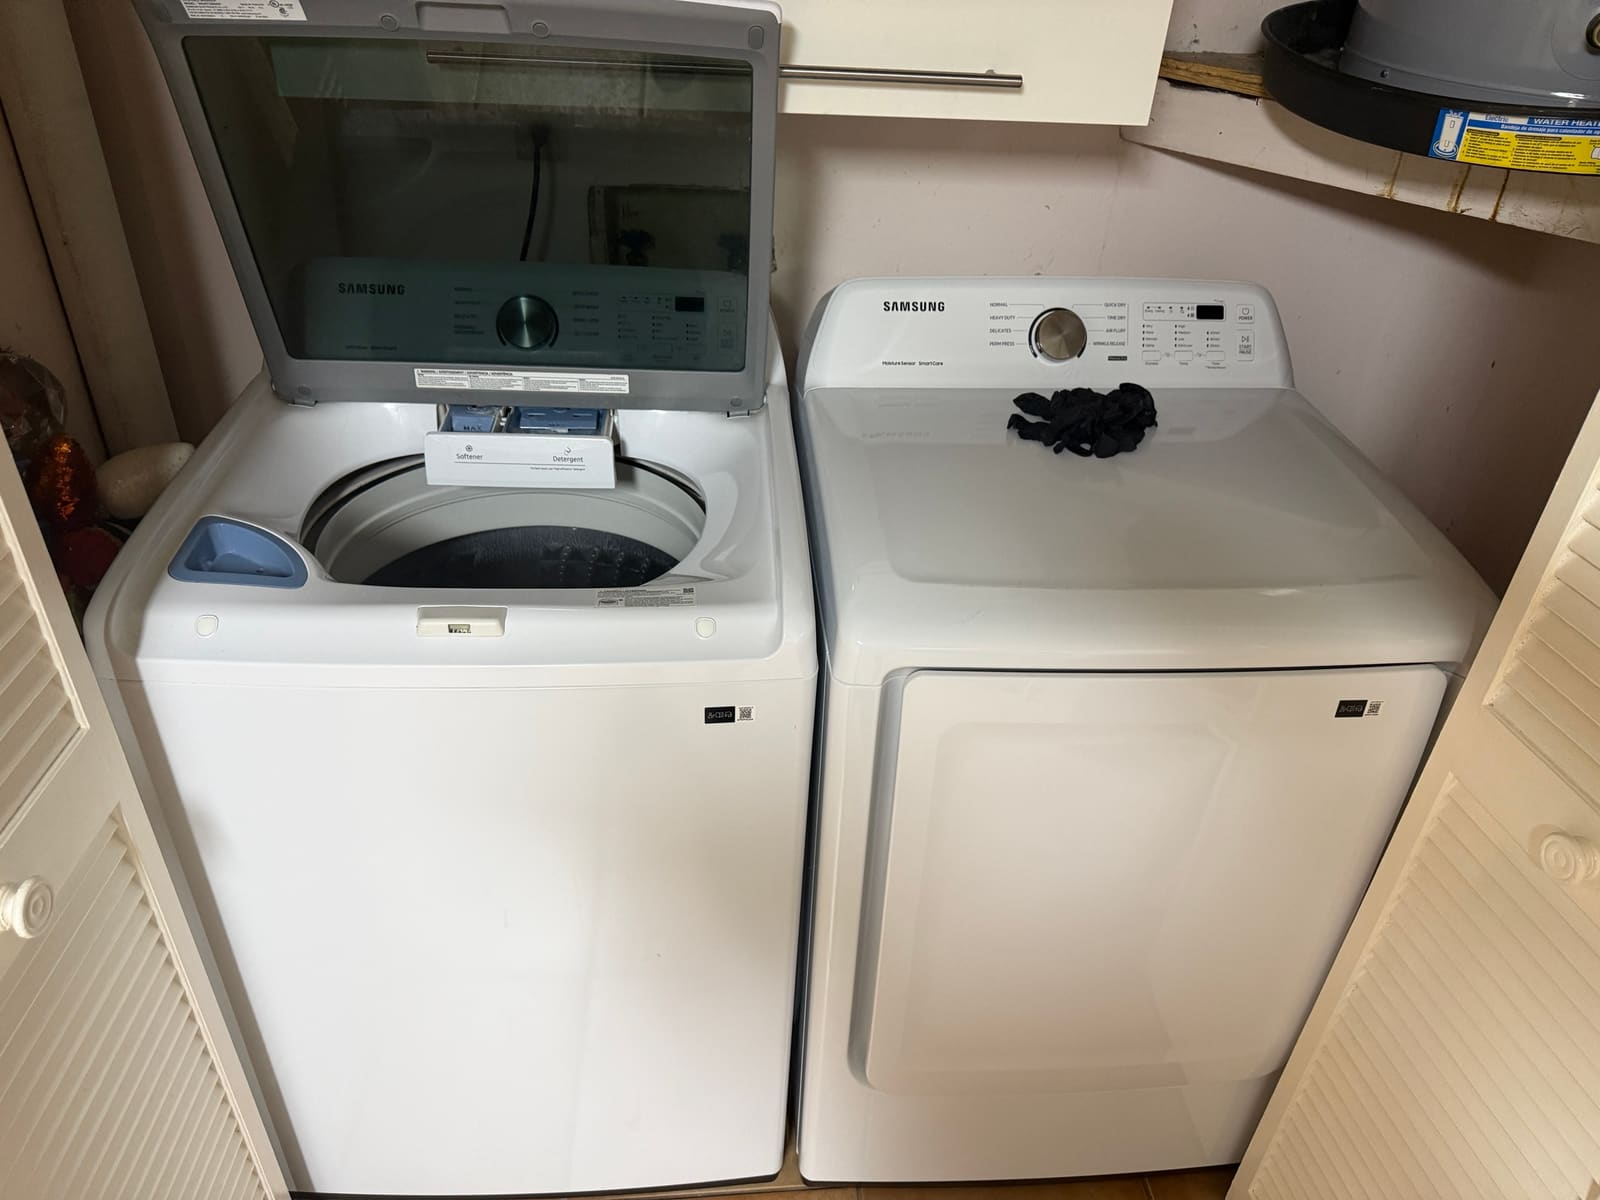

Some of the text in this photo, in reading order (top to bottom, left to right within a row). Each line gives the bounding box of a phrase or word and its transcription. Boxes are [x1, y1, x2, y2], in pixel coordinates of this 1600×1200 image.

[1534, 118, 1567, 126] WATER
[338, 282, 405, 295] SAMSUNG
[883, 301, 945, 312] SAMSUNG
[552, 455, 584, 463] Detergent
